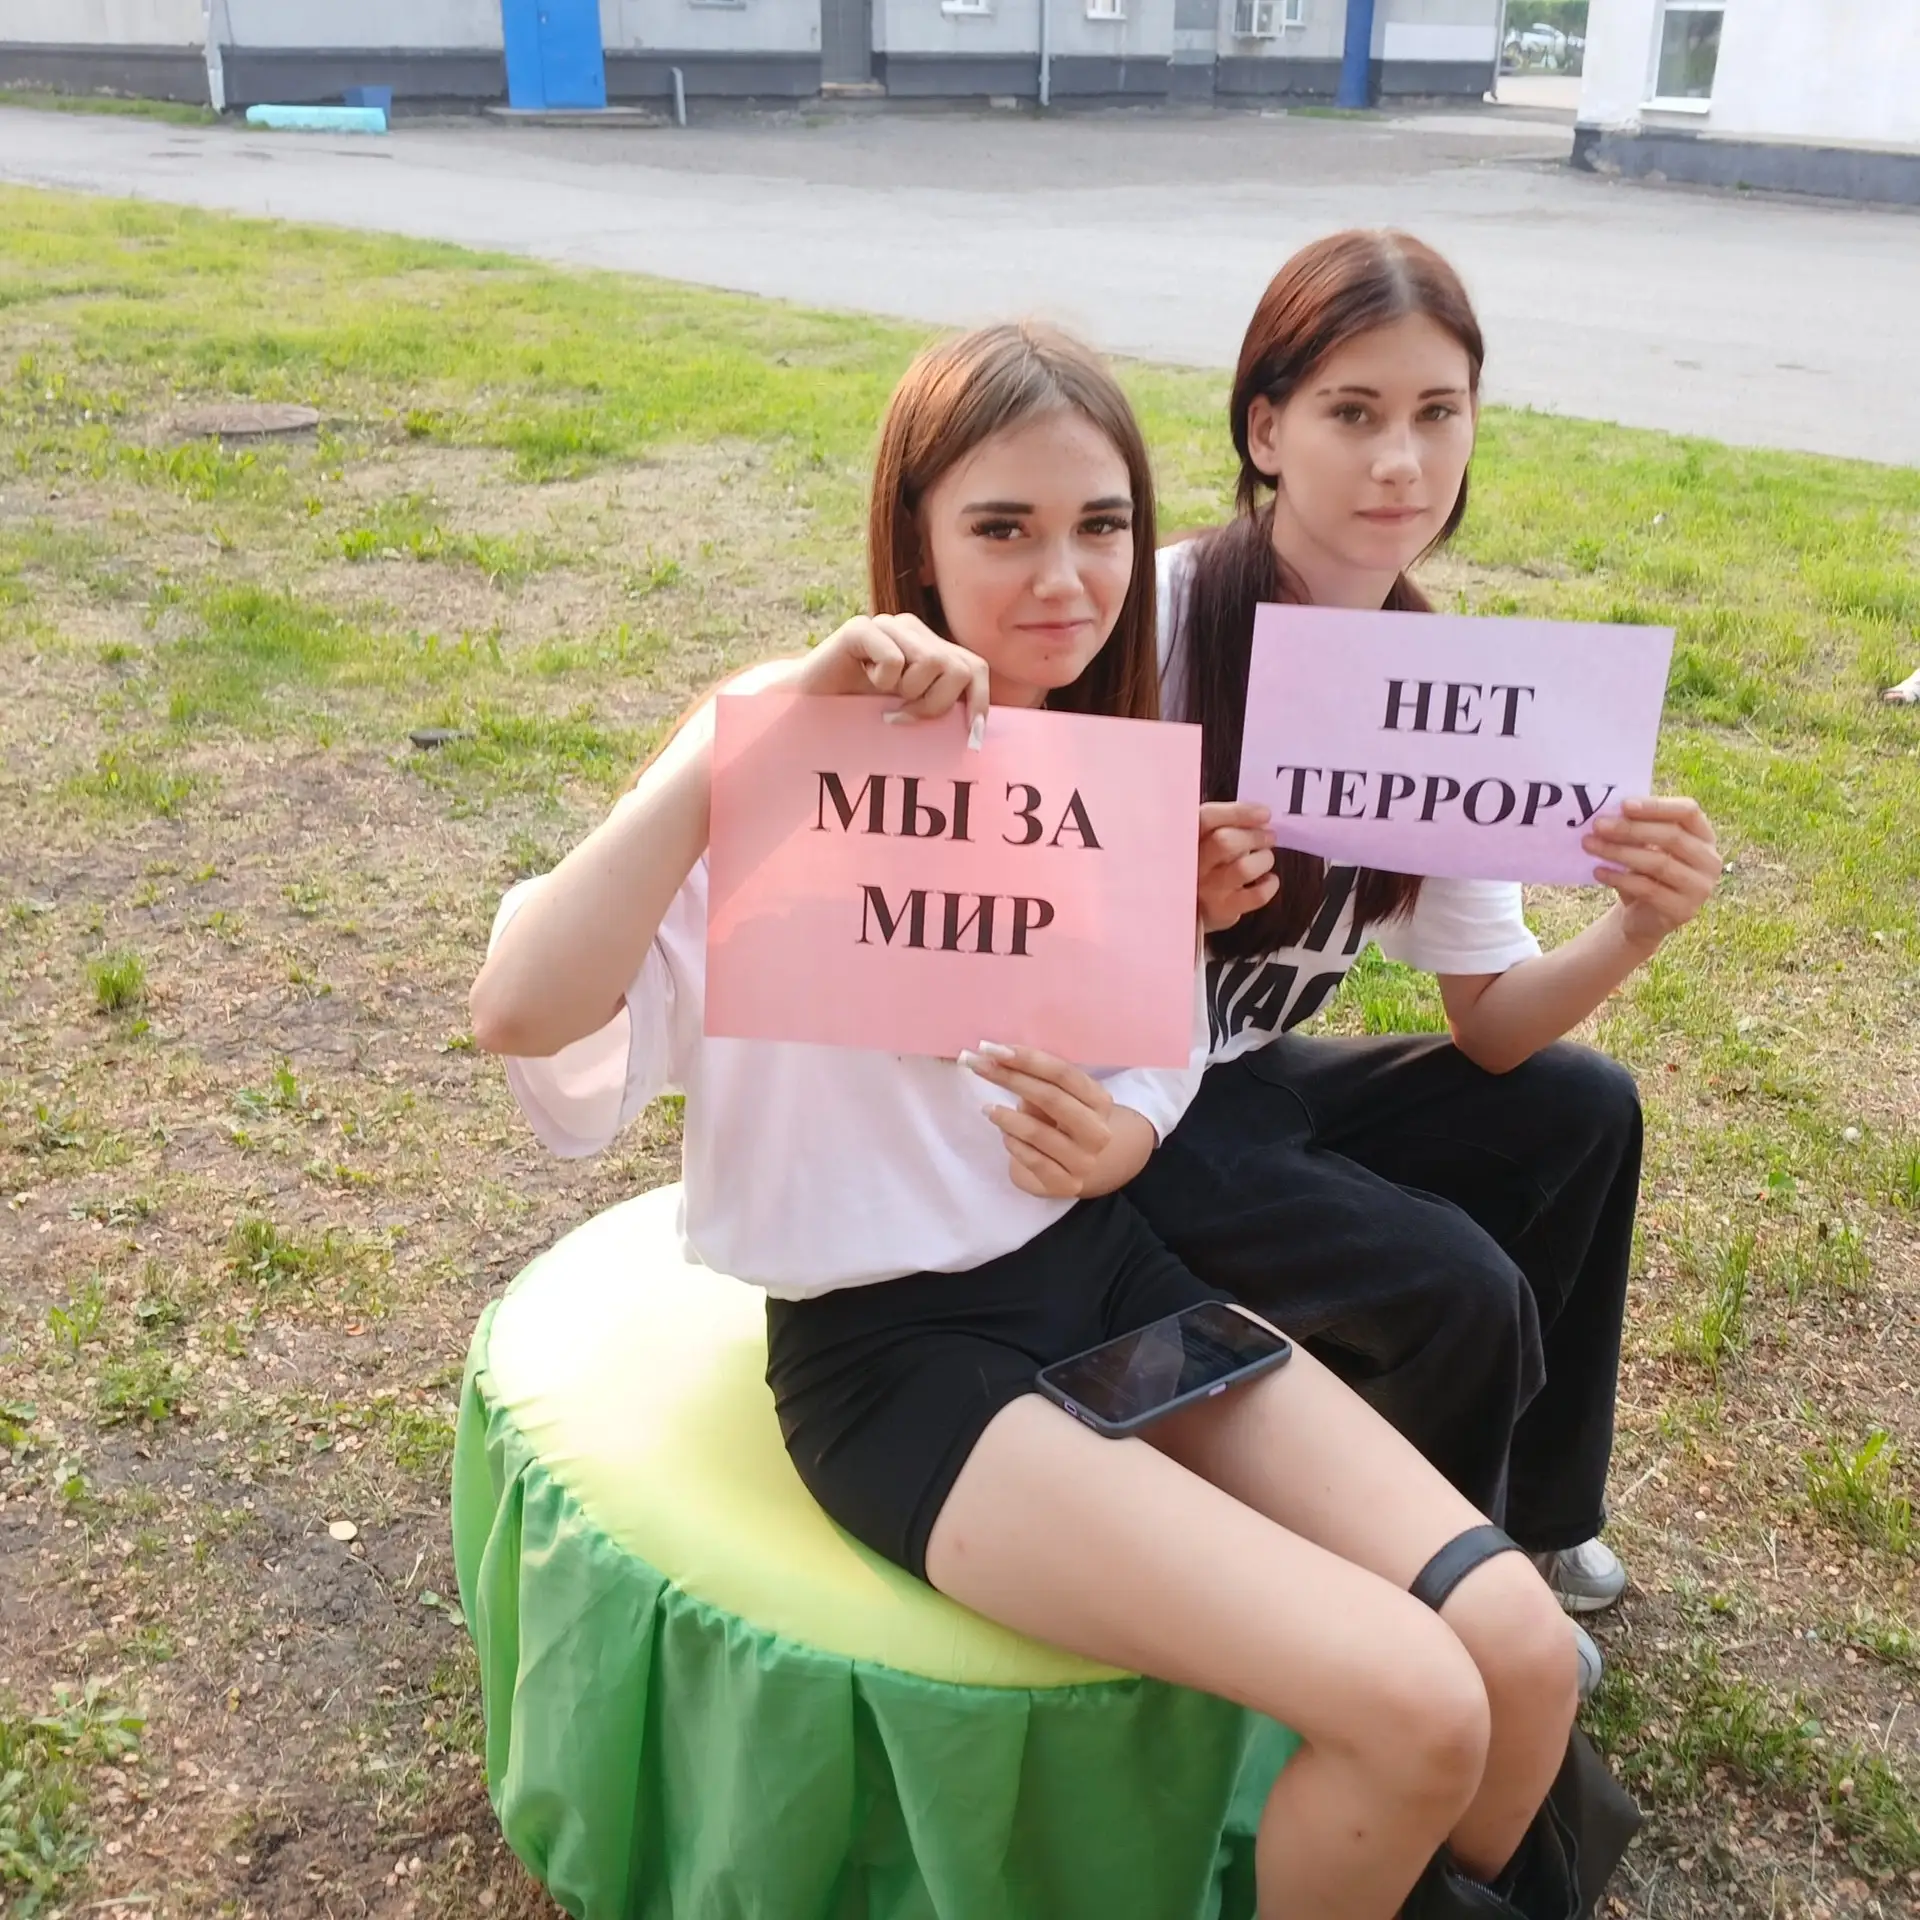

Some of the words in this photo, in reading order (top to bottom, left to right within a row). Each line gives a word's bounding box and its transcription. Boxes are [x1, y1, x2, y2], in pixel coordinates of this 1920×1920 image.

[1379, 678, 1536, 738] НЕТ
[811, 769, 979, 843] МЫ
[1001, 780, 1105, 850] ЗА
[1276, 765, 1618, 828] ТЕРРОРУ
[855, 883, 1055, 957] МИР
